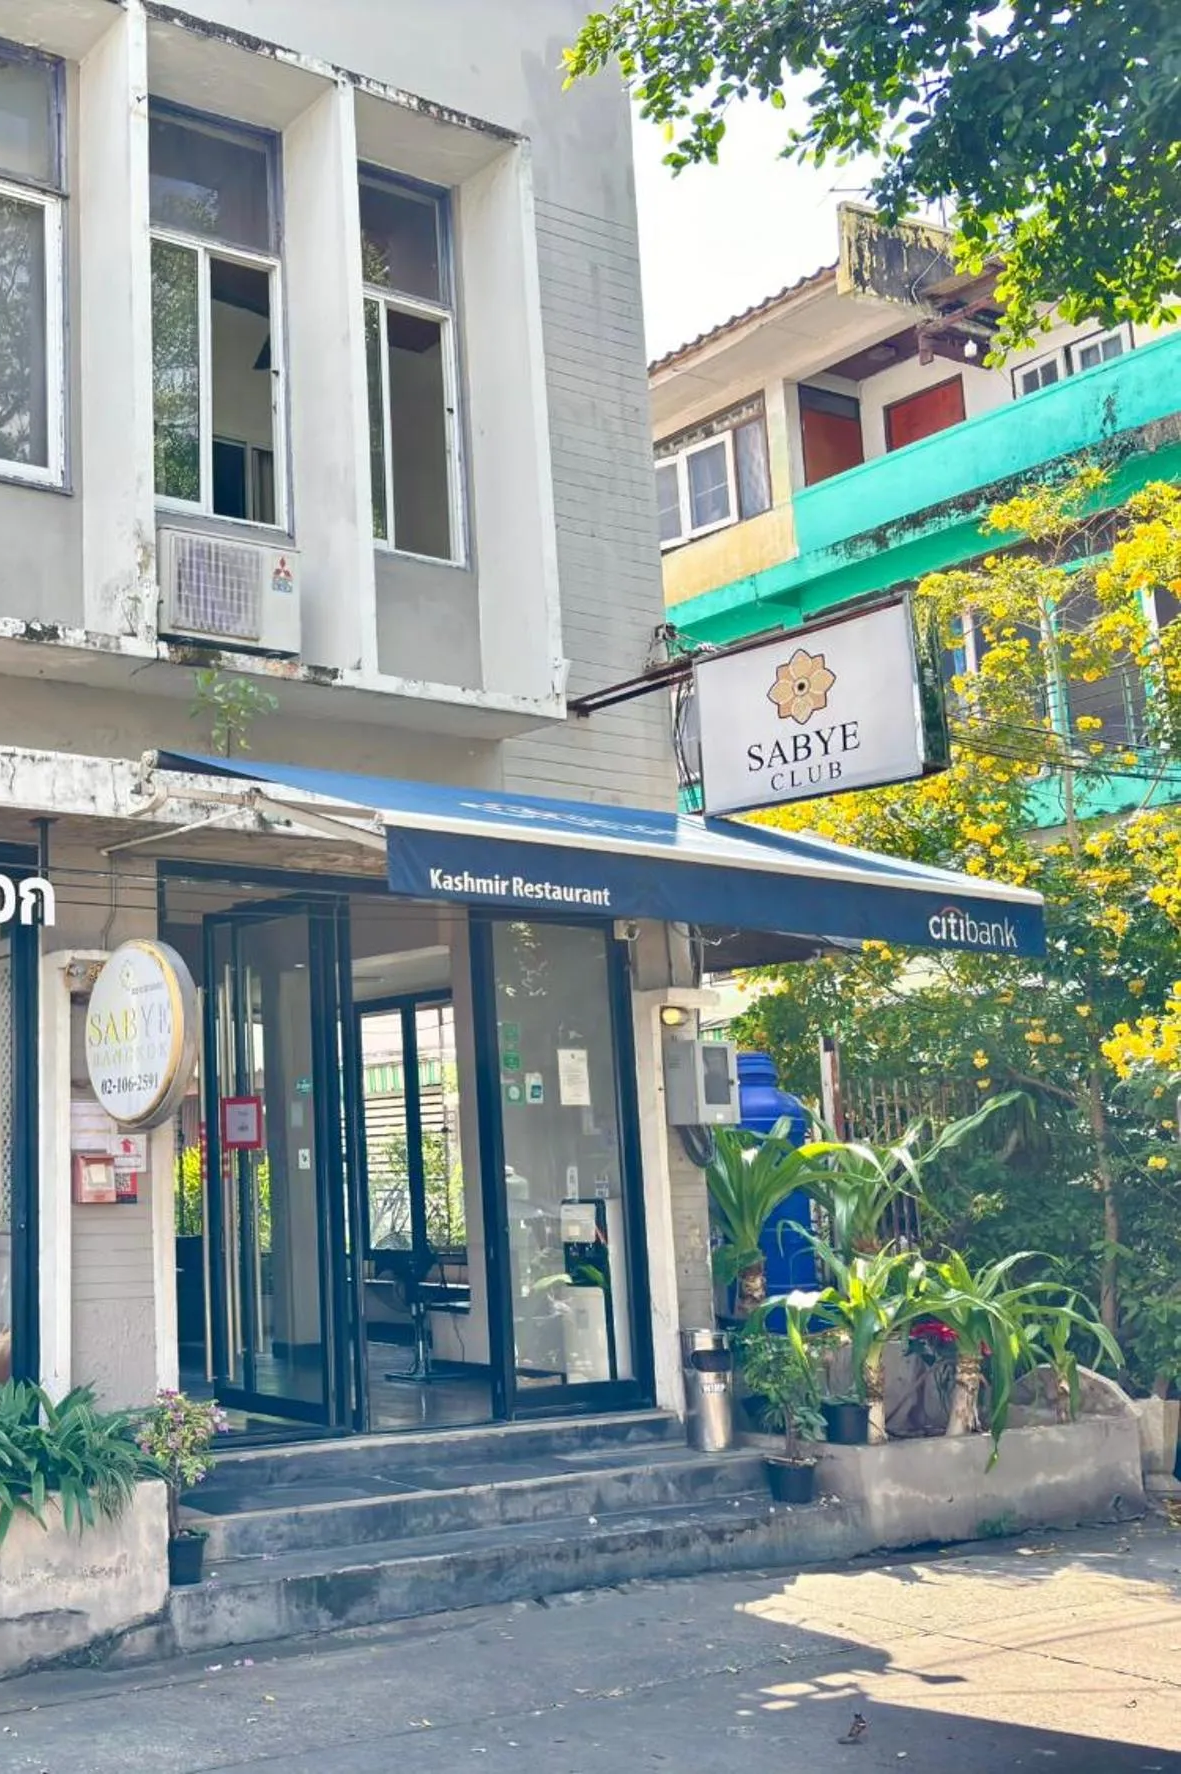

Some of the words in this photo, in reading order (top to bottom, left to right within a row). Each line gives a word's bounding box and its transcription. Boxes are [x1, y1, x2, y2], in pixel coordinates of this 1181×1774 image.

[747, 721, 860, 772] SABYE
[771, 761, 842, 791] CLUB
[430, 868, 509, 896] Kashmir
[512, 877, 611, 907] Restaurant
[928, 909, 1018, 948] citibank
